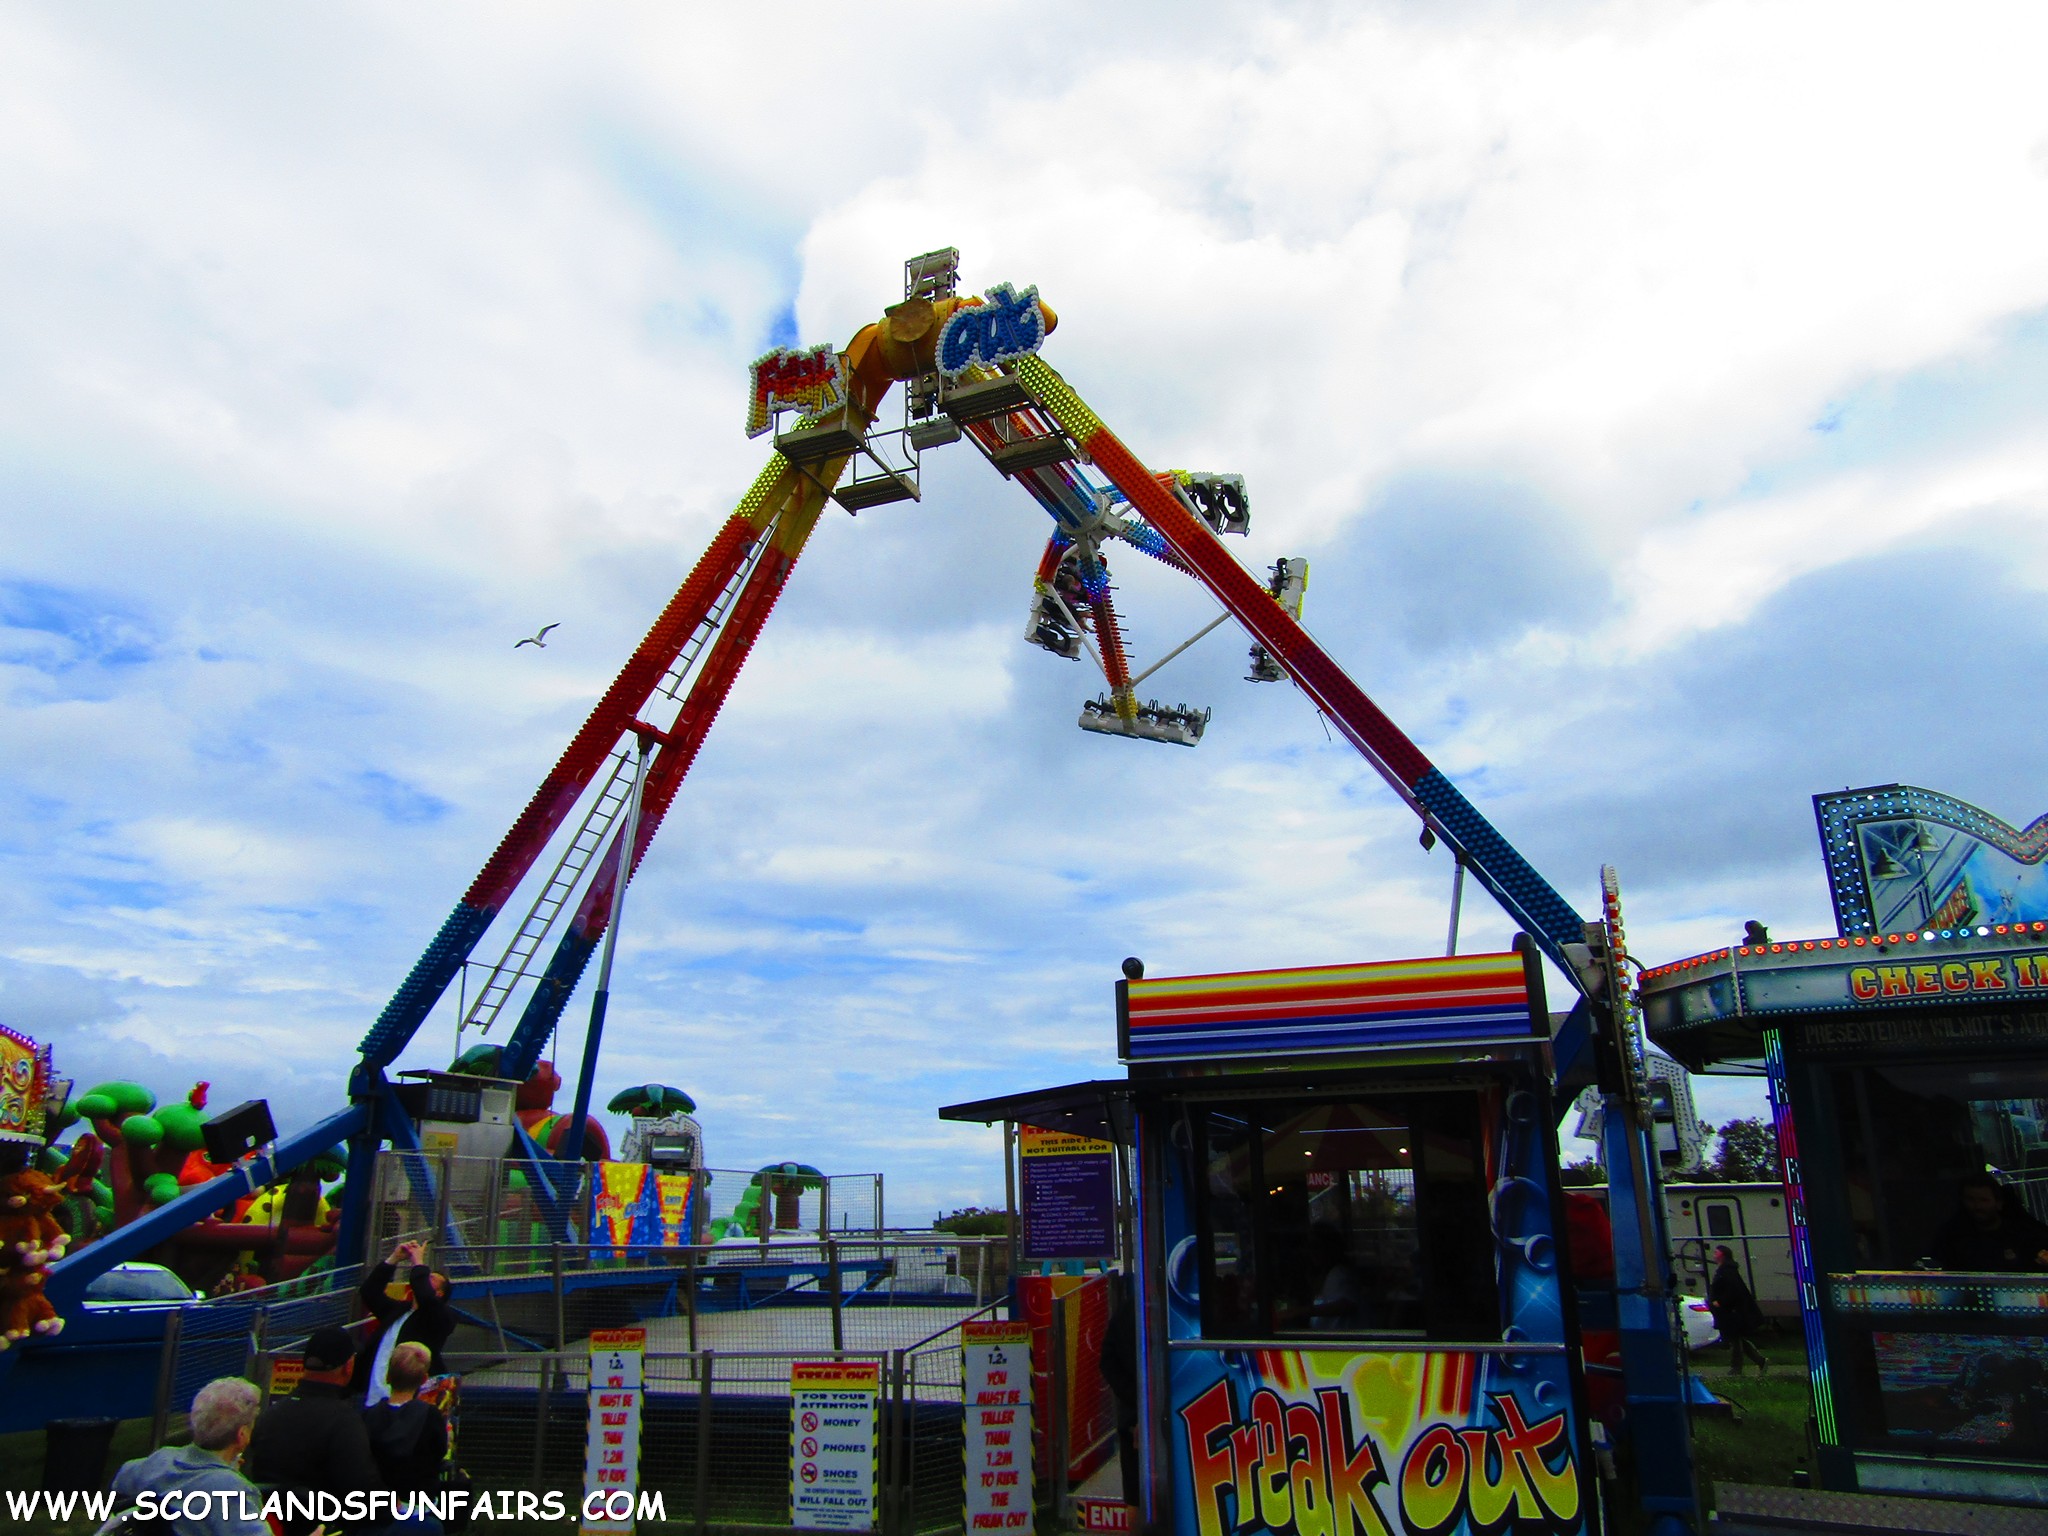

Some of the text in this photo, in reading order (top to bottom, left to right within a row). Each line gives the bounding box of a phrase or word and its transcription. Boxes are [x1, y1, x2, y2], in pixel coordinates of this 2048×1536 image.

[1850, 960, 2006, 1001] CHECK
[1804, 1020, 1898, 1045] PRESENTED
[1901, 1018, 1924, 1040] BY
[1928, 1014, 2014, 1039] WILMOT'S
[797, 1368, 875, 1379] FREAK OUT
[986, 1371, 1008, 1386] YOU
[608, 1376, 624, 1388] YOU
[598, 1394, 634, 1407] MUST BE
[976, 1390, 1021, 1405] MUST BE
[601, 1412, 628, 1426] TALLER
[823, 1418, 862, 1427] MONEY
[981, 1410, 1015, 1426] TALLER
[602, 1431, 624, 1445] THAN
[985, 1430, 1012, 1446] THAN
[823, 1444, 866, 1452] PHONES
[986, 1450, 1014, 1466] 1.2M
[1177, 1377, 1581, 1536] Freak out
[598, 1468, 628, 1482] TO RIDE
[823, 1470, 858, 1478] SHOES
[981, 1470, 1019, 1487] TO RIDE
[800, 1496, 868, 1506] WILL FALL OUT
[991, 1492, 1010, 1506] THE
[973, 1512, 1028, 1528] FREAK OUT
[1091, 1506, 1129, 1528] ENT
